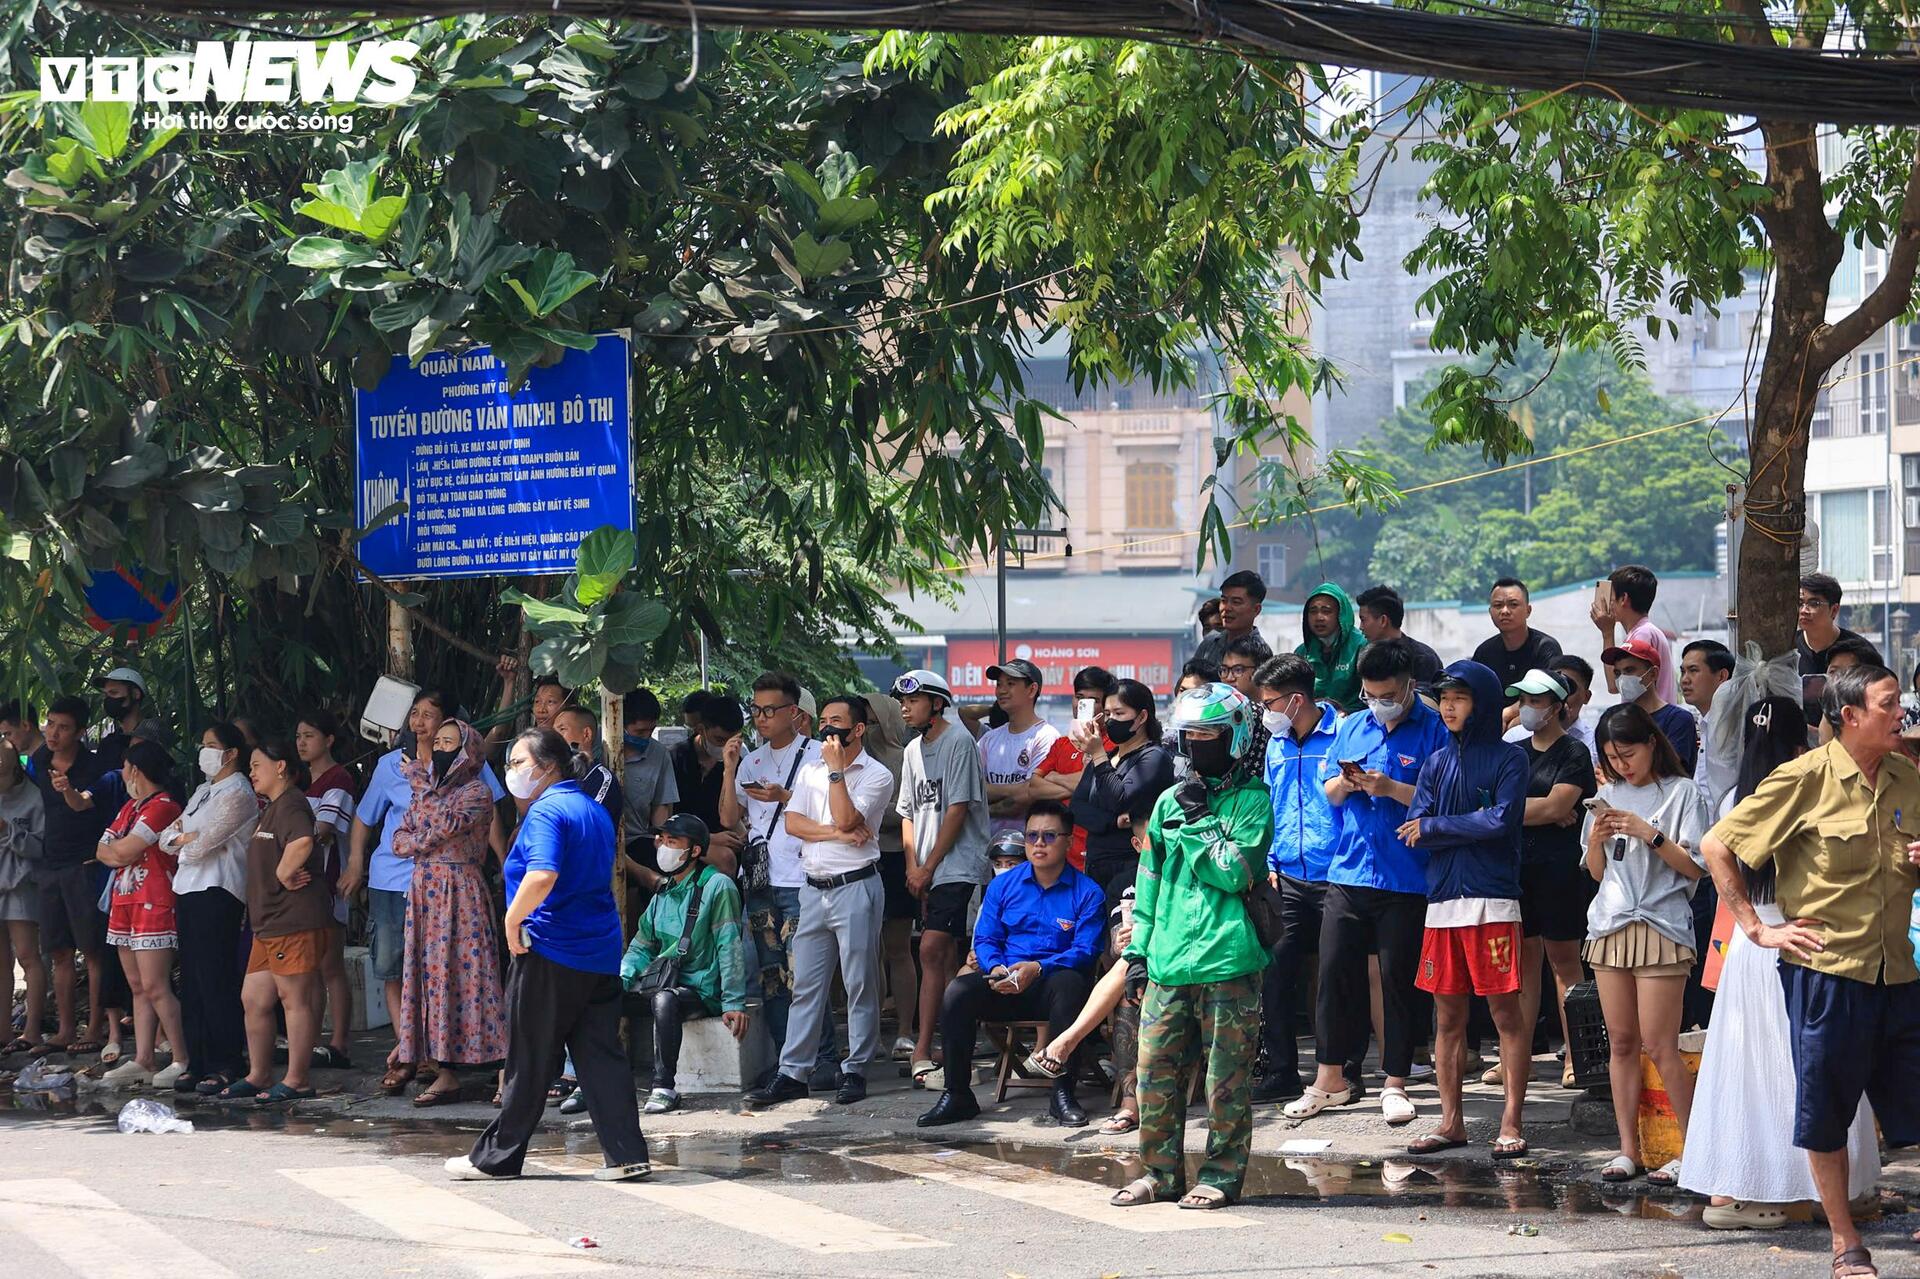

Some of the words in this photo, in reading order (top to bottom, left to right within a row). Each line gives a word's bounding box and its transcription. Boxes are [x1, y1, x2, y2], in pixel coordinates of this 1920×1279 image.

[420, 356, 457, 377] QUẬN
[463, 355, 494, 371] NAM
[443, 382, 479, 397] PHƯỜNG
[482, 380, 496, 394] MỸ
[525, 380, 530, 390] 2
[370, 406, 417, 439] TUYẾN
[421, 404, 472, 435] ĐƯỜNG
[476, 401, 508, 430] VĂN
[513, 401, 555, 427] MINH
[562, 394, 583, 424] ĐÔ
[588, 397, 613, 426] THỊ
[461, 443, 469, 453] XE
[471, 439, 485, 452] MÁY
[487, 441, 497, 451] SAI
[499, 439, 512, 451] QUY
[514, 438, 530, 450] ĐỊNH
[451, 457, 468, 469] LÒNG
[503, 455, 519, 465] KINH
[515, 469, 529, 480] LÀM
[586, 464, 596, 476] MỸ
[598, 464, 616, 476] QUAN
[440, 493, 449, 502] AN
[468, 490, 483, 501] GIAO
[478, 506, 486, 516] RA
[488, 503, 505, 515] LÒNG
[574, 498, 589, 509] SINH
[565, 529, 578, 542] CÁO
[475, 552, 483, 564] VÀ
[485, 551, 499, 564] CÁC
[520, 552, 527, 561] VI
[1034, 646, 1074, 657] HOÀNG
[1077, 648, 1100, 657] SƠN
[951, 662, 982, 689] ĐIỆN
[1488, 936, 1510, 965] 17
